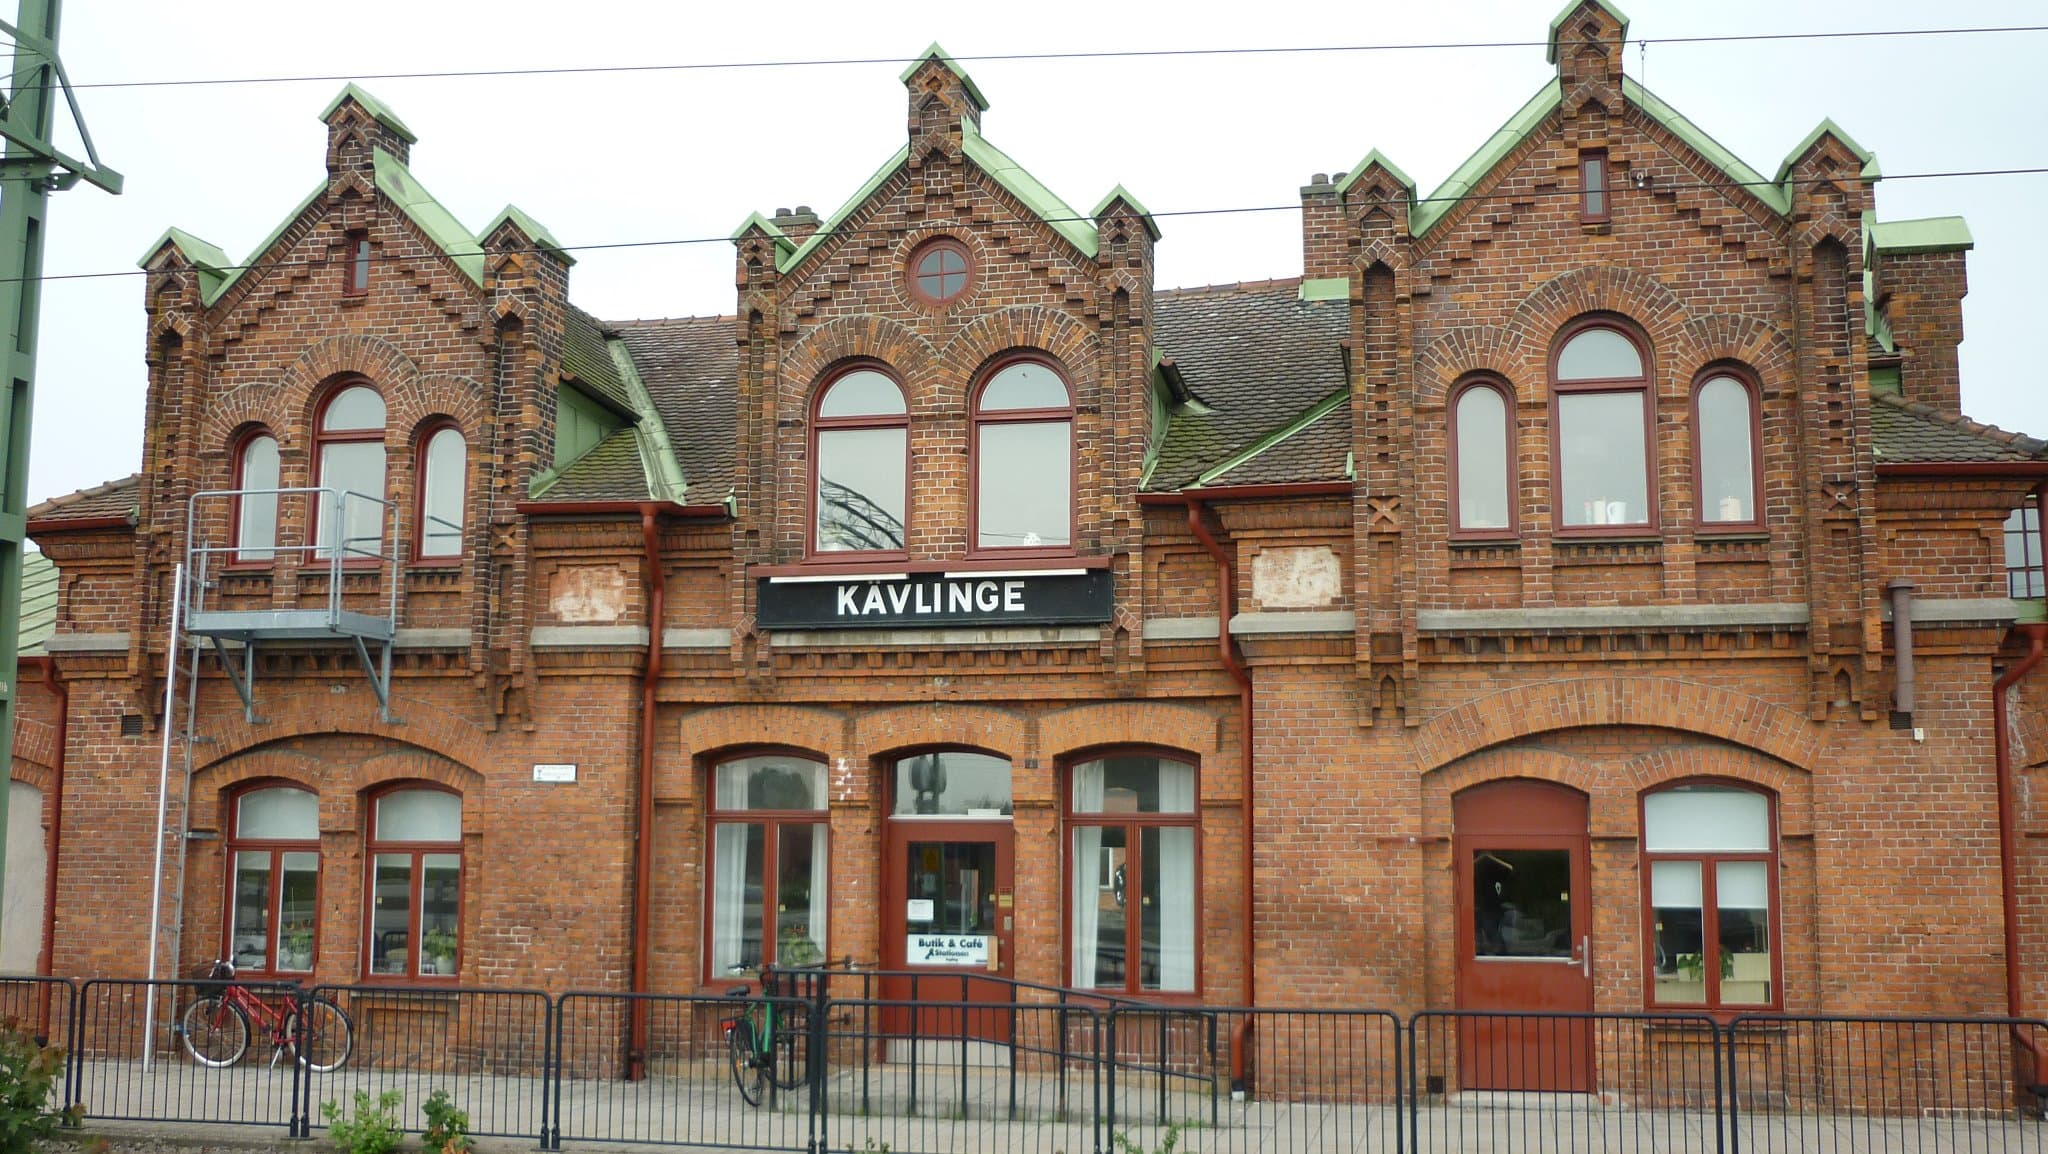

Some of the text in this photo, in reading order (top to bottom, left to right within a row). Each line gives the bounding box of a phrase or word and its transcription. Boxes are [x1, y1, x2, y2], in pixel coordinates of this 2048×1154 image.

[837, 581, 1025, 615] KÄVLINGE
[918, 938, 983, 948] Butik & Café
